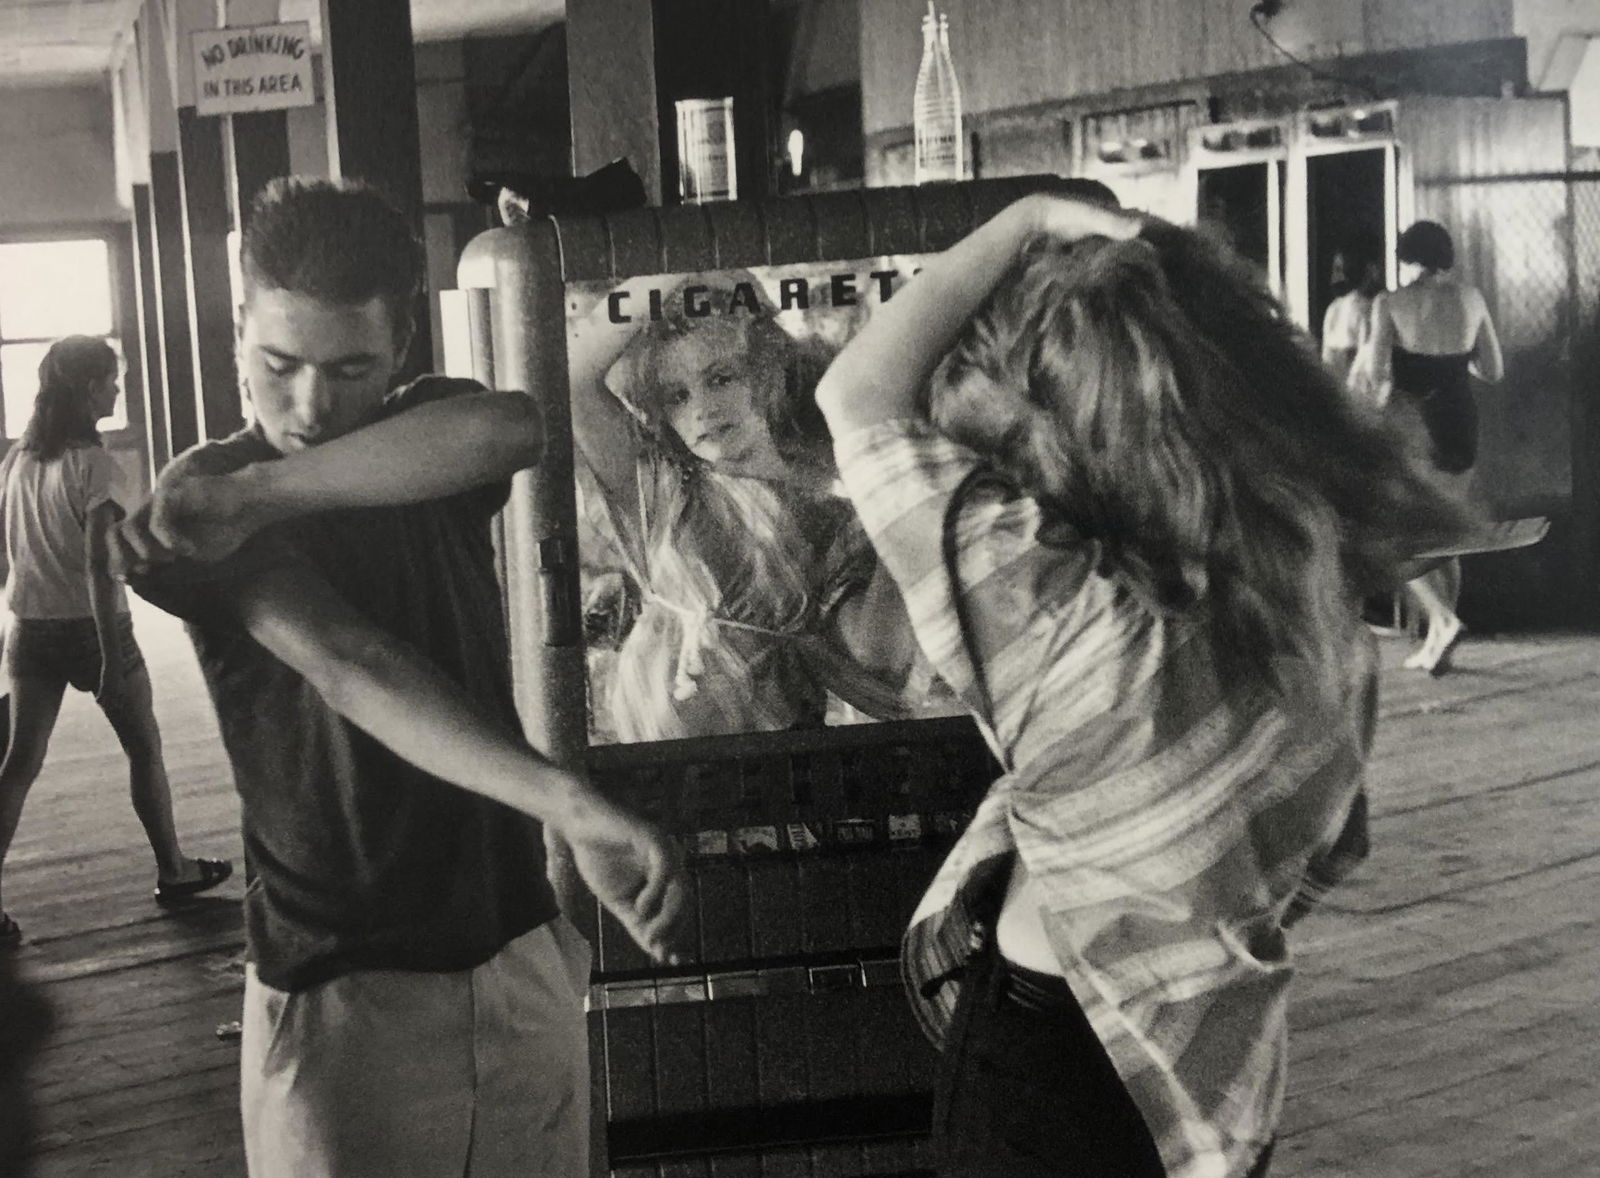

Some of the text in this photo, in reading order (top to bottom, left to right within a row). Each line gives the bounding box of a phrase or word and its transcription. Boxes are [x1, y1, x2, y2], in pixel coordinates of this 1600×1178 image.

[201, 33, 304, 68] NO DRINKING
[203, 73, 302, 98] IN THIS AREA
[607, 268, 922, 324] CIGARET
